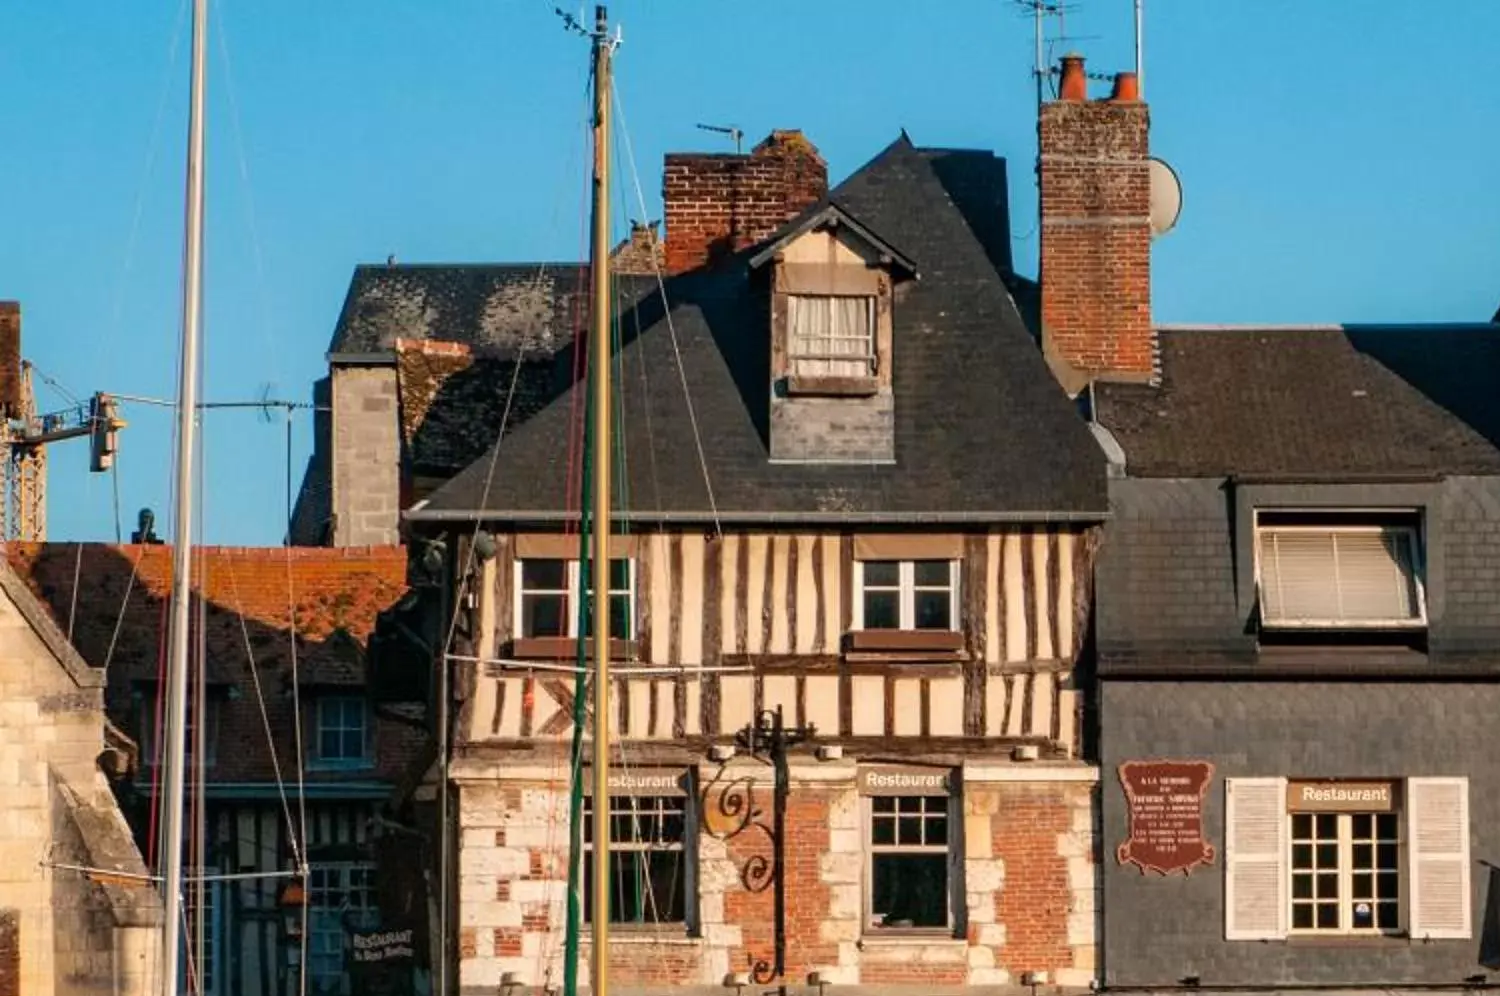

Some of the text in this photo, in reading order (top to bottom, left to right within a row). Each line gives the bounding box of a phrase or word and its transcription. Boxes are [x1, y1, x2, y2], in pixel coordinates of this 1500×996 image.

[608, 774, 678, 788] staurant
[867, 772, 946, 787] Restauran
[1303, 787, 1387, 801] Restaurant
